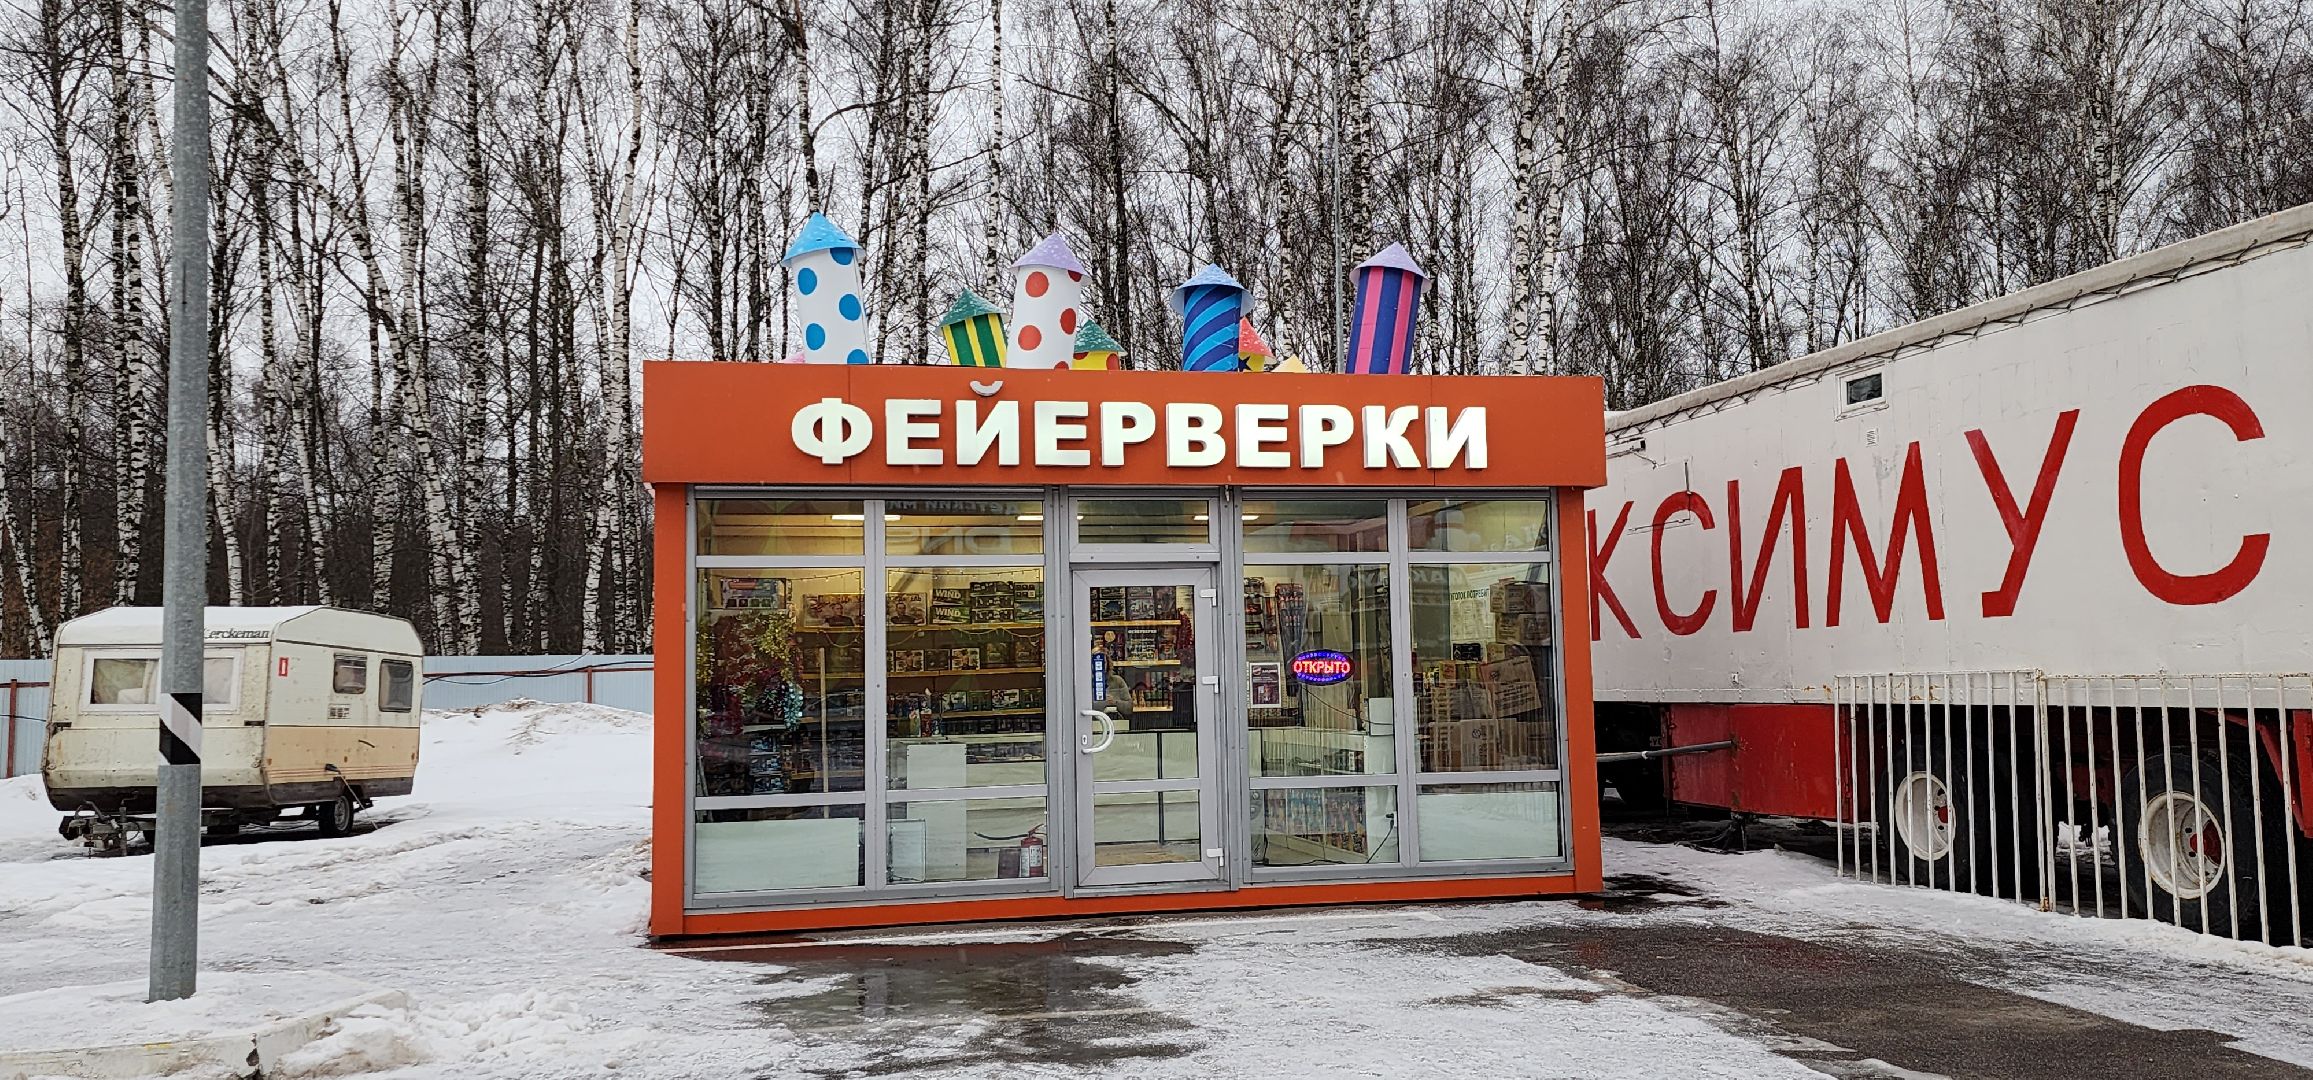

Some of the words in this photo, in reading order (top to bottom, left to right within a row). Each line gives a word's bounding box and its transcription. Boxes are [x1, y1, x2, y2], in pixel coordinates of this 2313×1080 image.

[790, 380, 1488, 470] ФЕЙЕРВЕРКИ
[935, 589, 961, 599] WIND
[935, 607, 961, 617] WIND
[1293, 660, 1351, 674] ОТКРЫТО
